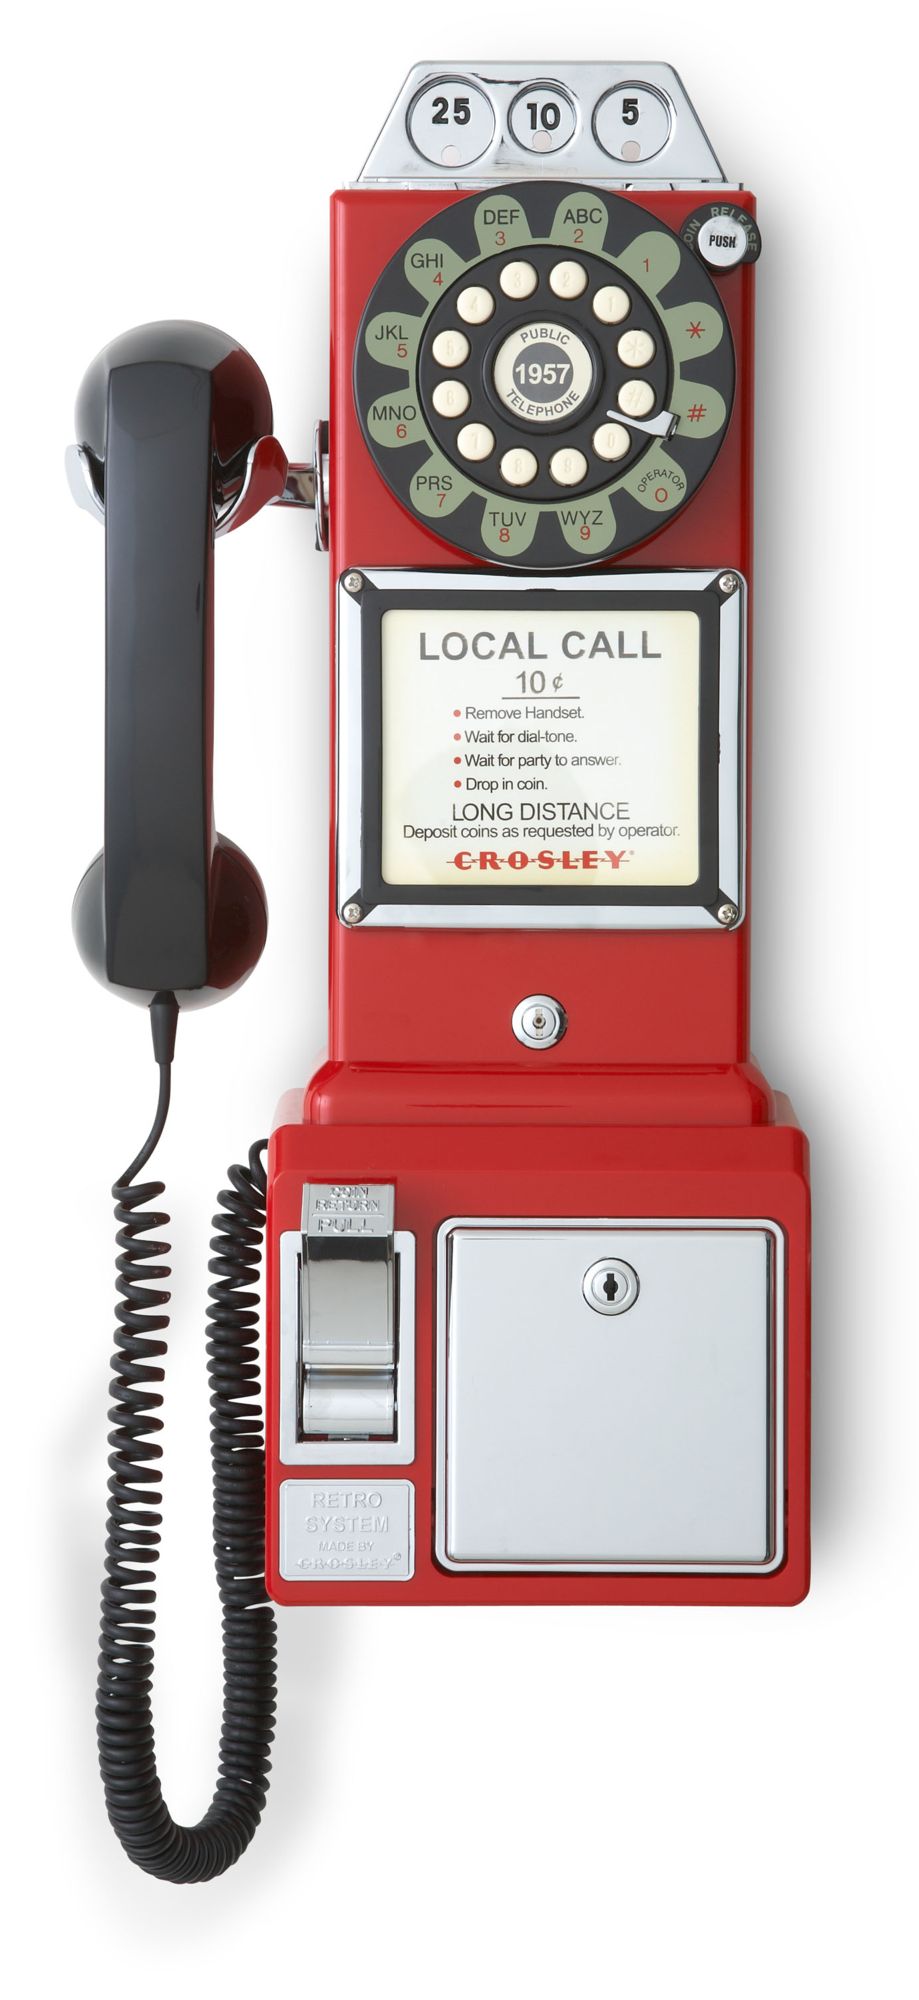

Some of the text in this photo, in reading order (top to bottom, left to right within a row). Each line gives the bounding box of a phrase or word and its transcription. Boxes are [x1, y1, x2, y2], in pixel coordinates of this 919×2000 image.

[431, 96, 471, 125] 25
[526, 102, 561, 130] 10
[621, 98, 639, 125] 5
[484, 209, 520, 224] DEF
[563, 208, 602, 223] ABC
[573, 228, 584, 243] 2
[710, 206, 757, 252] RELEASE
[495, 231, 506, 246] 3
[708, 234, 736, 248] PUSH
[410, 253, 444, 269] GHI
[643, 258, 650, 273] 1
[432, 272, 444, 286] 4
[375, 325, 409, 340] JKL
[520, 327, 571, 345] PUBLIC
[397, 343, 408, 358] 5
[515, 363, 571, 385] 1957
[506, 388, 581, 417] TELEPHONE
[372, 405, 416, 421] MNO
[687, 404, 706, 422] #
[396, 423, 407, 439] 6
[416, 475, 453, 491] PRS
[637, 469, 685, 493] OPERATOR
[436, 493, 446, 508] 7
[489, 512, 527, 526] TUV
[561, 510, 603, 526] WYZ
[499, 528, 510, 543] 8
[580, 525, 591, 540] 9
[419, 630, 663, 660] LOCAL CALL
[516, 670, 564, 694] 10 ¢
[465, 706, 585, 719] Remove Handset.
[464, 730, 578, 744] Wait for dial-tone.
[464, 753, 622, 769] Wait for party to answer.
[466, 777, 548, 793] Drop in coin.
[452, 801, 631, 821] LONG DISTANCE
[403, 823, 680, 842] Deposit coins as requested by operator.
[330, 1186, 369, 1199] COIN
[315, 1199, 380, 1212] RETURN
[317, 1217, 374, 1233] PULL
[311, 1491, 383, 1509] RETRO
[304, 1515, 389, 1533] SYSTEM
[318, 1541, 374, 1552] MADE BY
